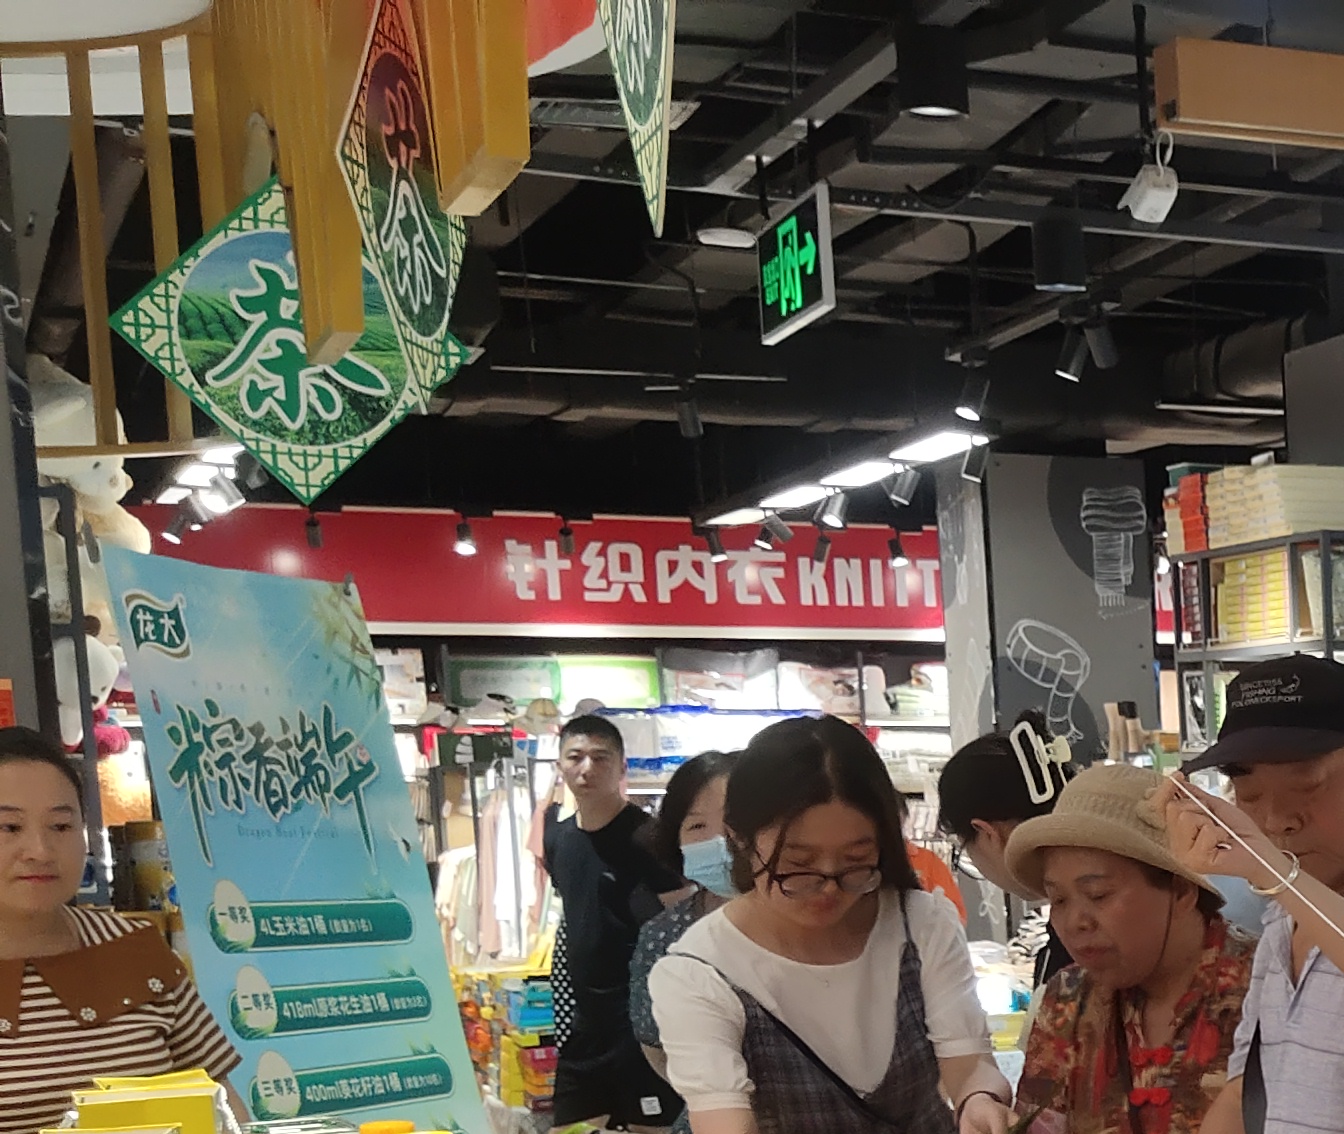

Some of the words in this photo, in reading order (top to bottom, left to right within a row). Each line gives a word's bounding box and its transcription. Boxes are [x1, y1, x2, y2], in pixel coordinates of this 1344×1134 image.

[204, 253, 392, 431] 茶
[504, 539, 787, 606] 针织内衣
[218, 905, 250, 925] 一等奖
[241, 992, 274, 1011] 二等奖
[261, 1076, 297, 1097] 三等奖
